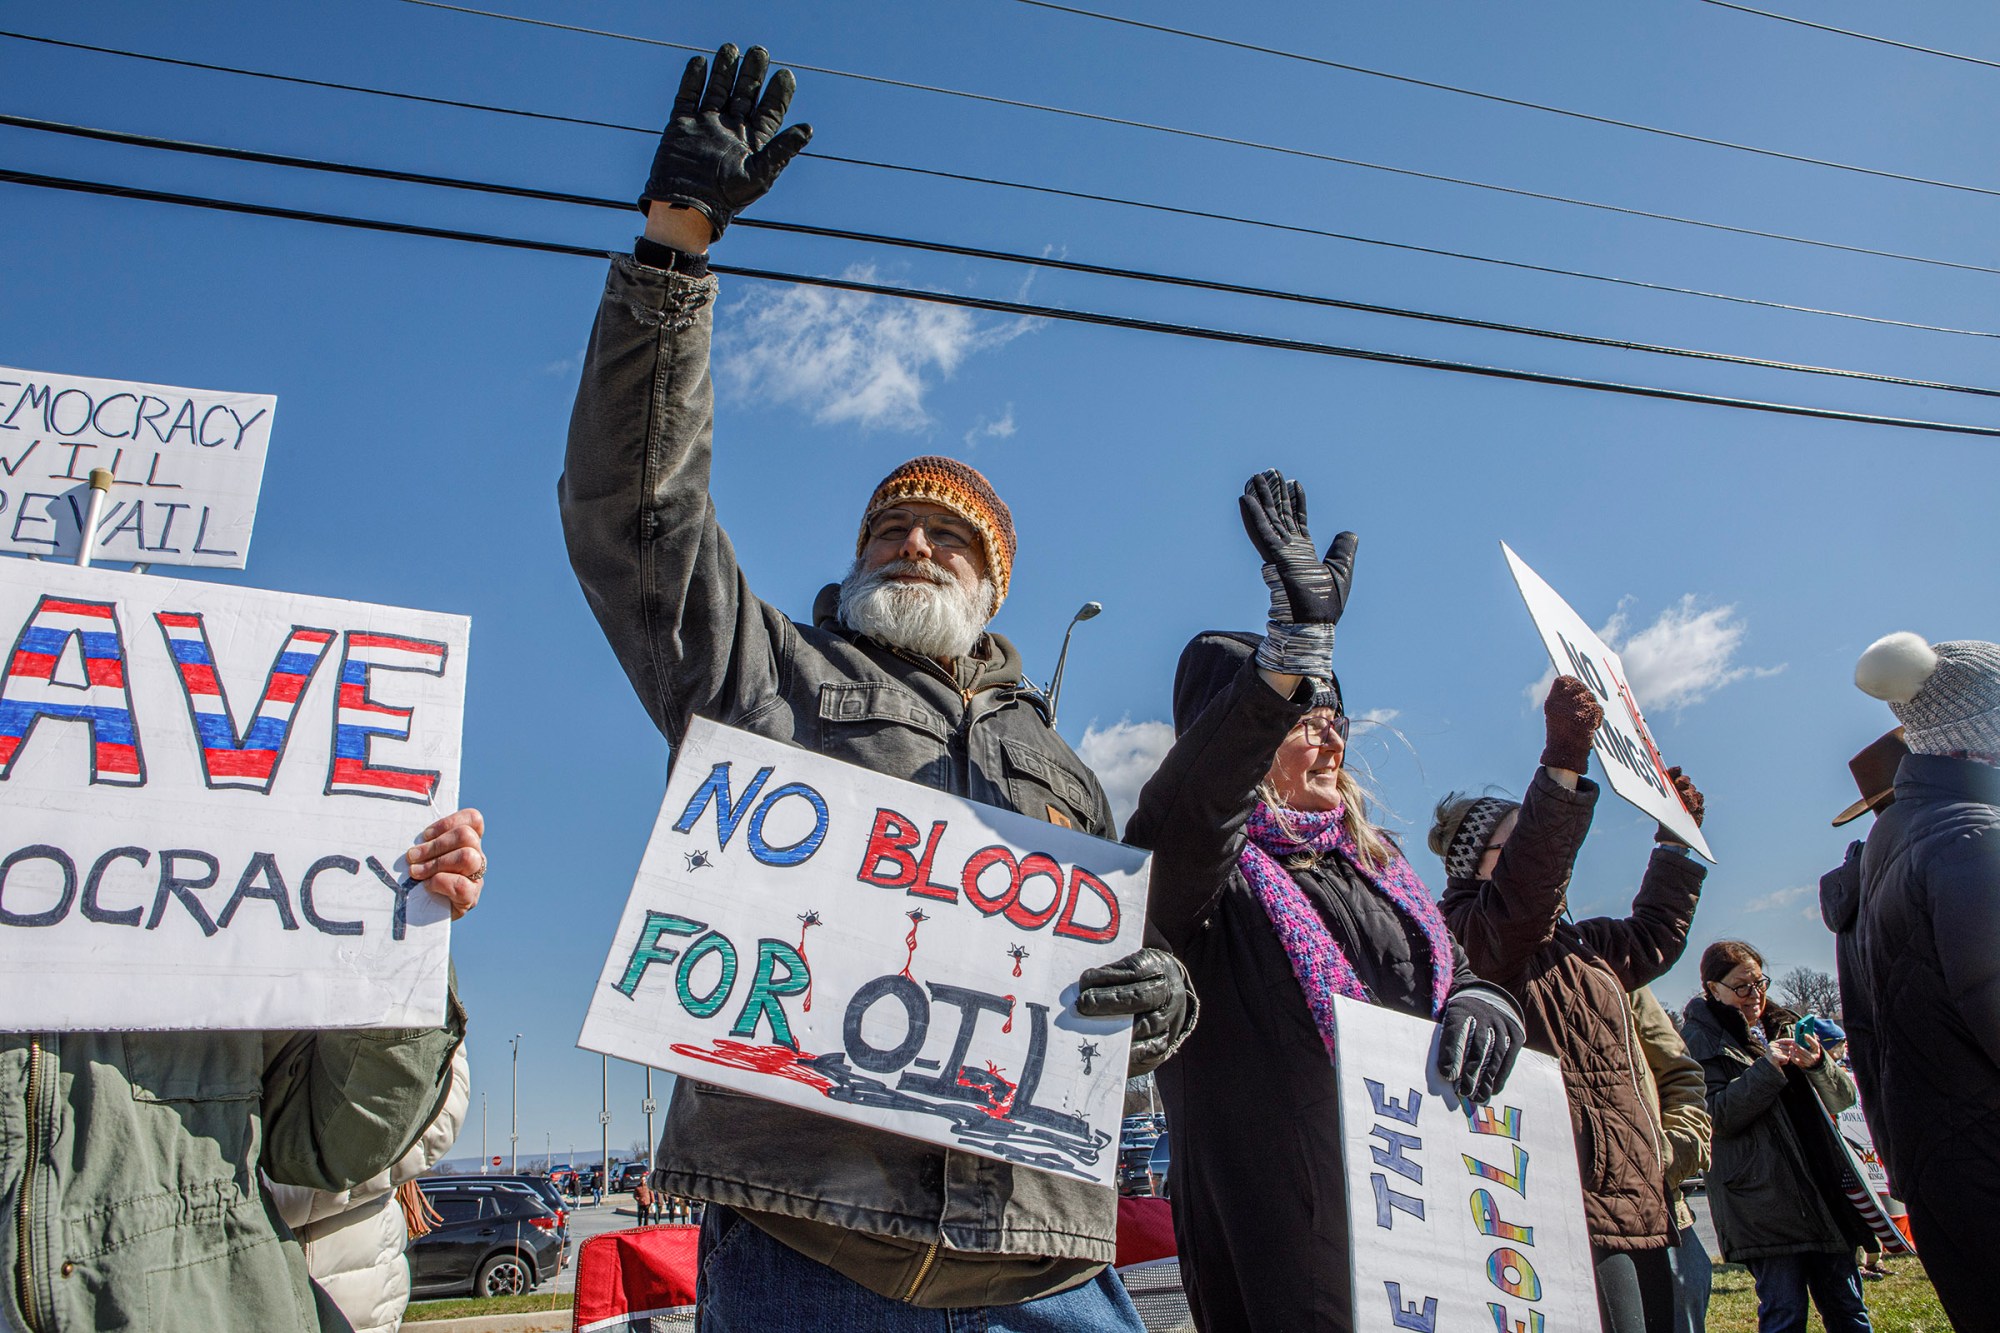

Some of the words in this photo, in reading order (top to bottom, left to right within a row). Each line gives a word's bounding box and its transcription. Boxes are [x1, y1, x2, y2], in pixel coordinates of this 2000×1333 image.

[0, 594, 449, 806] AVE
[1556, 630, 1609, 702] NO
[671, 761, 829, 867] NO
[857, 807, 1120, 944] BLOOD
[611, 909, 811, 1053] FOR
[843, 974, 1093, 1143] OIL
[1363, 1077, 1426, 1230] THE
[1867, 1163, 1879, 1173] NO
